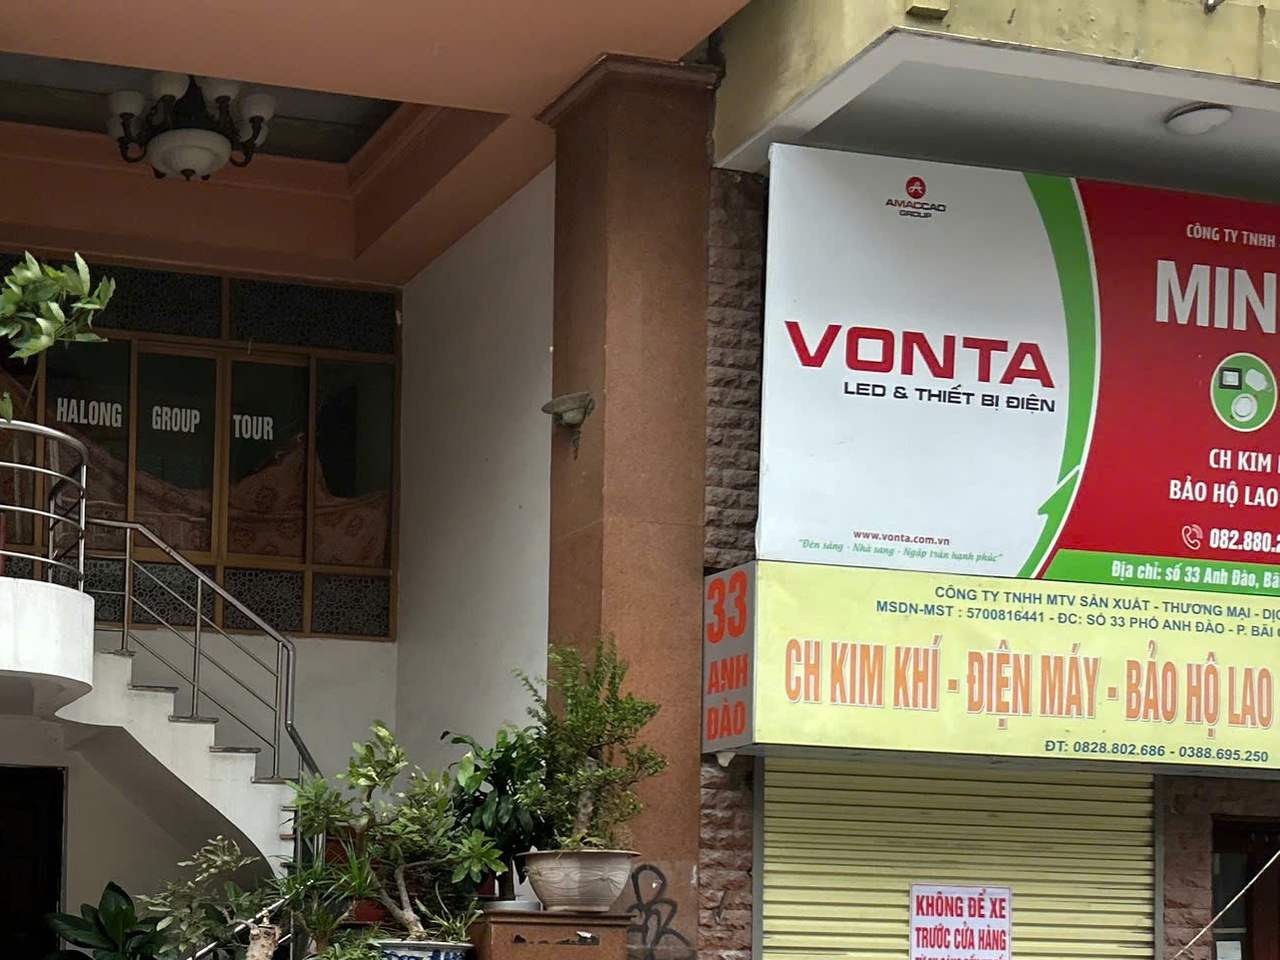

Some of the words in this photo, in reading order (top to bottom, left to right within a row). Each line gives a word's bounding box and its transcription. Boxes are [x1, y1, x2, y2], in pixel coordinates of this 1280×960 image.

[886, 199, 947, 212] AMACCAO
[899, 209, 932, 218] GROUP
[1186, 222, 1220, 241] CÔNG
[1223, 228, 1239, 243] TY
[1241, 231, 1276, 248] TNHH
[784, 320, 1055, 389] VONTA
[844, 382, 886, 397] LED
[893, 386, 908, 400] &
[914, 384, 975, 405] THIẾT
[981, 394, 999, 411] BỊ
[1006, 394, 1055, 414] ĐIỆN
[56, 397, 122, 428] HALONG
[151, 405, 200, 433] GROUP
[233, 414, 274, 441] TOUR
[1209, 449, 1232, 469] CH
[1238, 450, 1272, 473] KIM
[1169, 475, 1207, 502] BẢO
[1212, 480, 1239, 508] HỘ
[1244, 485, 1278, 508] LAO
[853, 530, 950, 546] www.vonta.com.vn
[1111, 560, 1133, 581] Địa
[1137, 561, 1162, 580] chỉ:
[1165, 562, 1183, 581] số
[1184, 566, 1200, 583] 33
[1203, 567, 1228, 585] Anh
[1231, 569, 1259, 589] Đào,
[706, 570, 748, 645] 33
[876, 600, 954, 617] MSDN-MST
[966, 607, 1044, 622] 5700816441
[1057, 612, 1082, 625] ĐC:
[1110, 615, 1125, 628] 33
[1162, 618, 1191, 632] ANH
[1195, 619, 1225, 634] ĐÀO
[1237, 624, 1247, 635] P.
[935, 584, 978, 601] CÔNG
[981, 590, 1000, 602] TY
[1003, 591, 1042, 605] TNHH
[1046, 594, 1076, 607] MTV
[1162, 601, 1223, 616] THƯƠNG
[1226, 606, 1251, 620] MẠI
[707, 653, 749, 695] ANH
[784, 637, 822, 703] CH
[830, 641, 885, 708] KIM
[892, 634, 942, 711] KHÍ
[966, 638, 1032, 730] ĐIỆN
[1039, 642, 1100, 719] MÁY
[1124, 639, 1178, 723] BẢO
[1185, 650, 1220, 740] HỘ
[1227, 665, 1273, 729] LAO
[706, 698, 747, 742] ĐÀO
[1044, 740, 1069, 753] ĐT:
[1073, 741, 1166, 756] 0828.802.686
[1178, 745, 1269, 762] 0388.695.250
[915, 891, 964, 917] KHÔNG
[967, 888, 986, 918] ĐỂ
[989, 897, 1007, 919] XE
[915, 923, 951, 949] TRƯỚC
[954, 921, 975, 950] CỬA
[978, 924, 1007, 951] HÀNG
